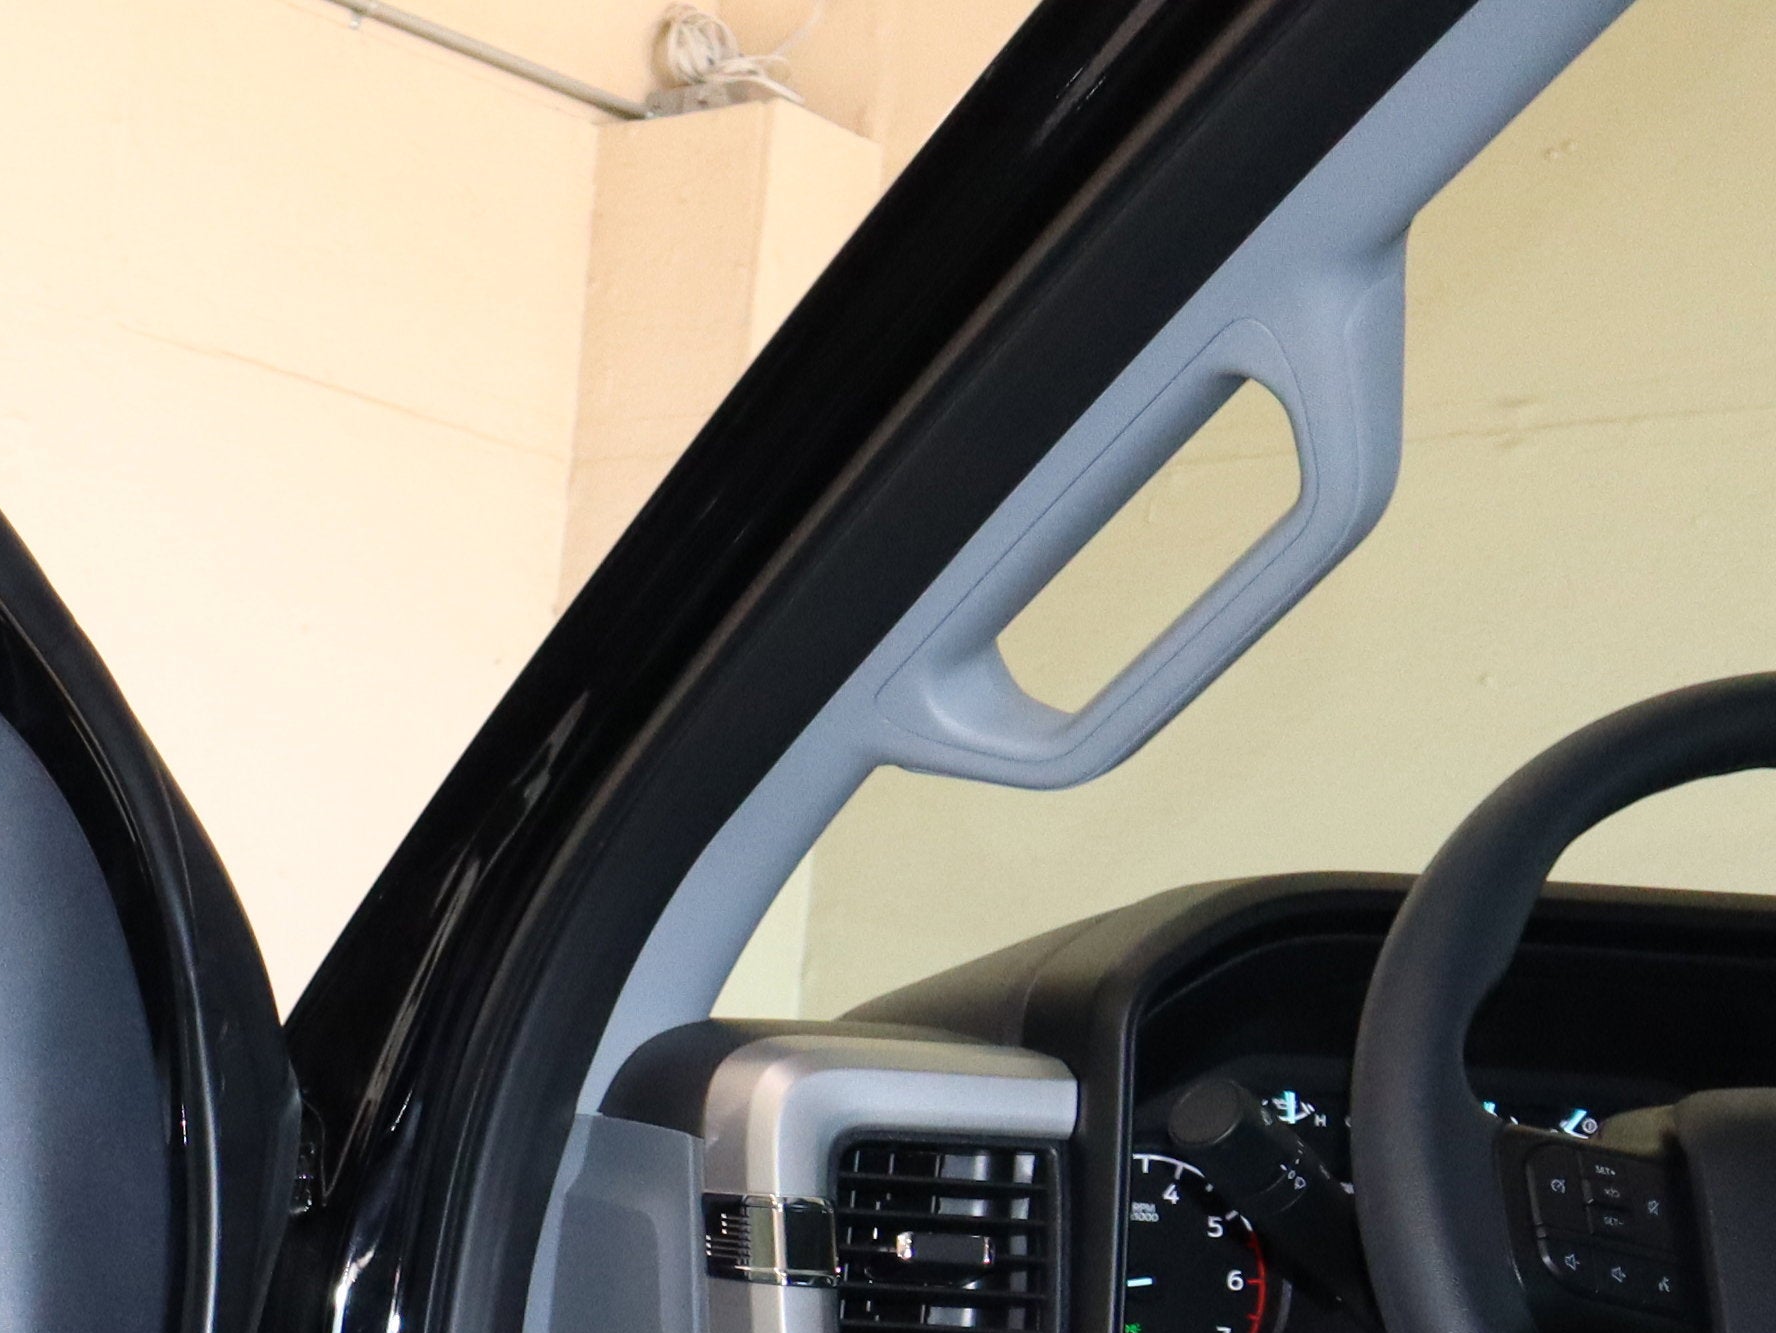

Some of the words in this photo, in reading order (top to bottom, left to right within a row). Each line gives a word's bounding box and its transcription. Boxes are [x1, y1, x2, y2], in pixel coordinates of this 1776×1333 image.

[1162, 1183, 1180, 1205] 4
[1207, 1216, 1224, 1238] 5
[1226, 1269, 1244, 1291] 6
